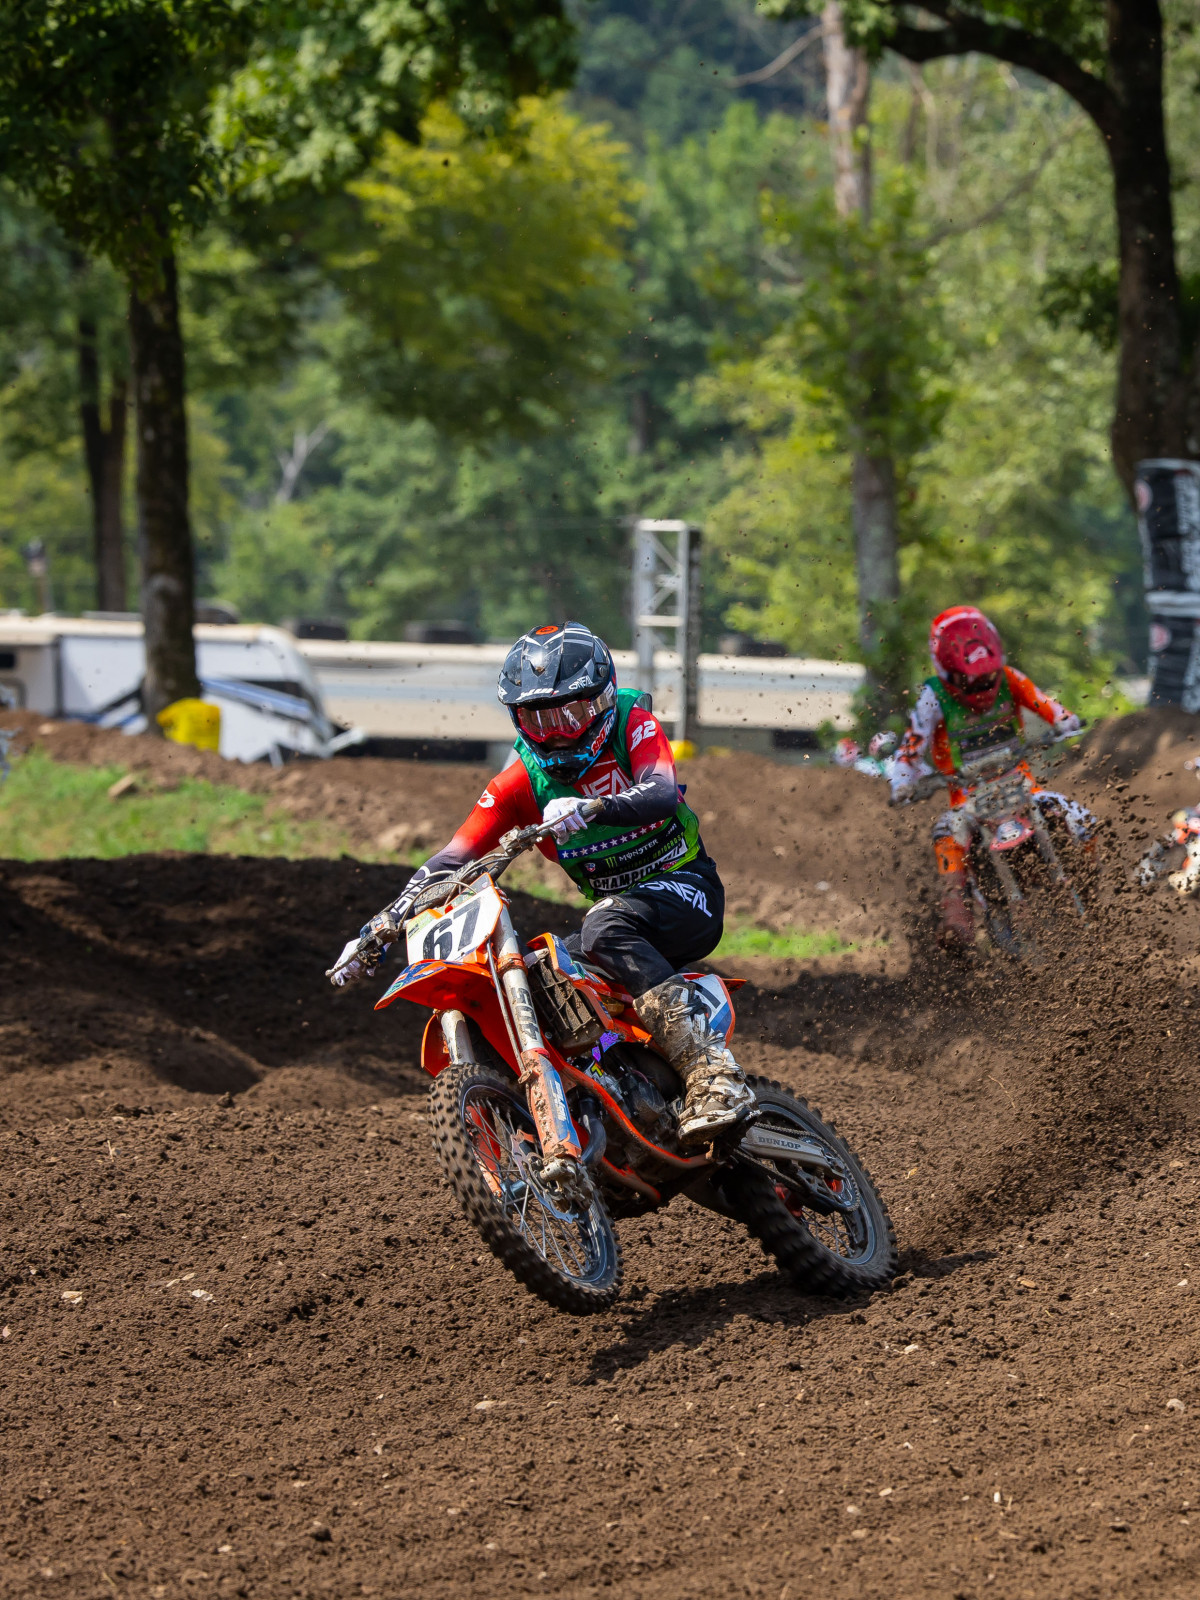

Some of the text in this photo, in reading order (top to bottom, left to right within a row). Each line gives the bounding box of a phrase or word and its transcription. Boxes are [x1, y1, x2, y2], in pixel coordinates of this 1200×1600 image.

[630, 720, 656, 752] 32
[619, 838, 659, 862] MONSTER
[423, 896, 481, 960] 67
[757, 1135, 802, 1150] DUNLOP
